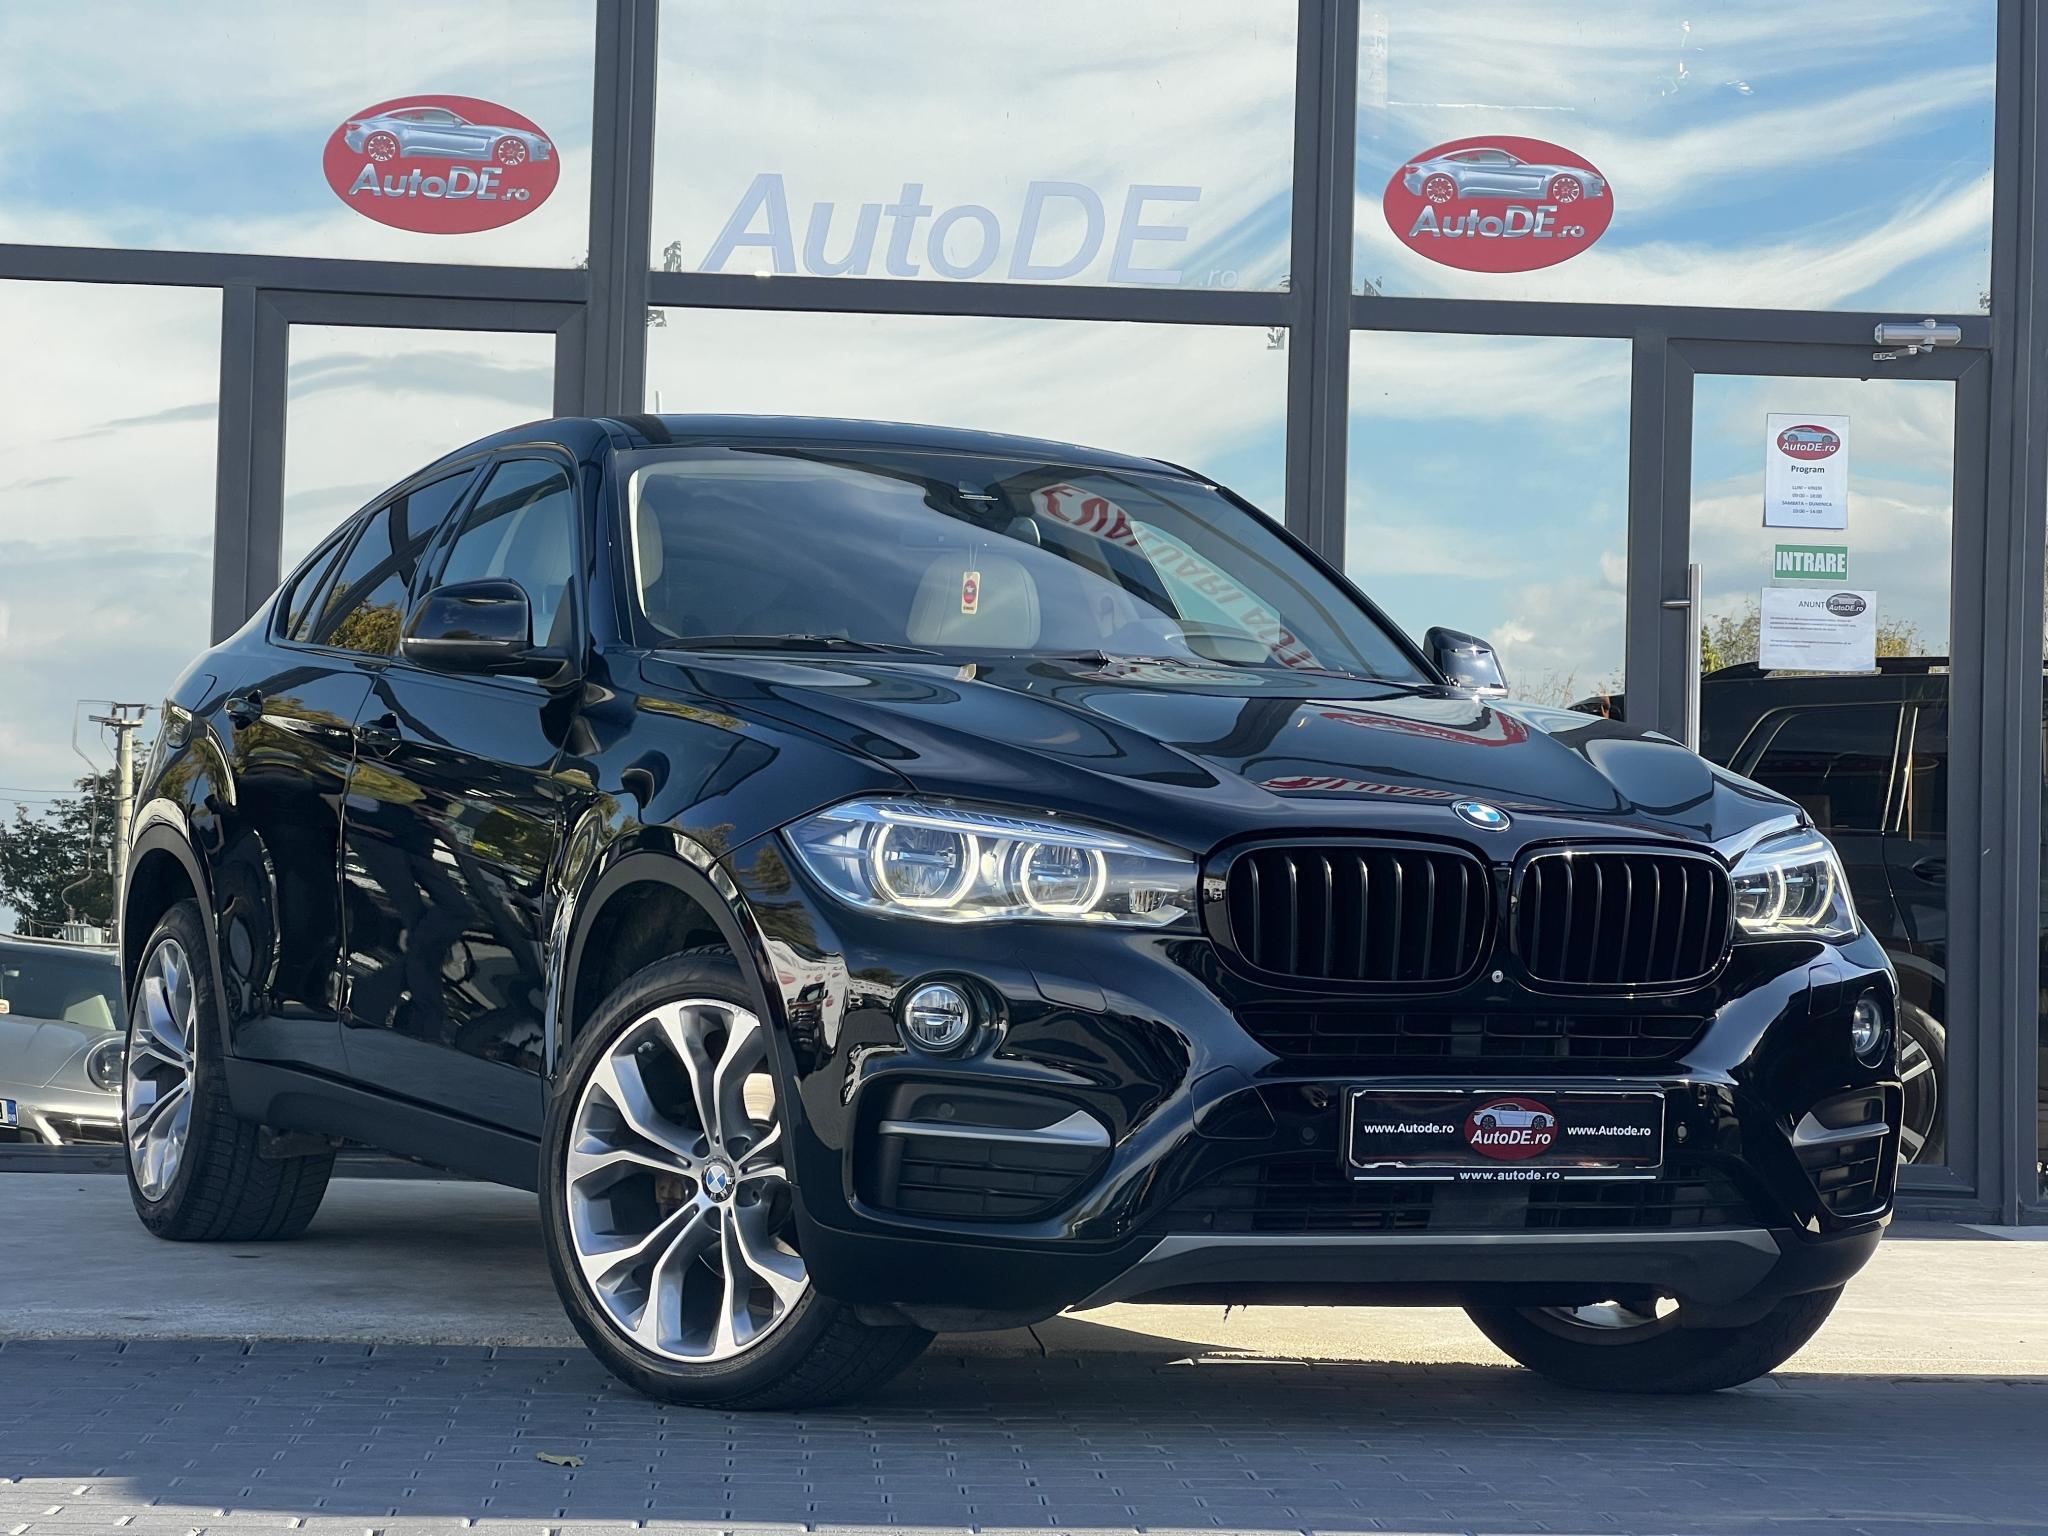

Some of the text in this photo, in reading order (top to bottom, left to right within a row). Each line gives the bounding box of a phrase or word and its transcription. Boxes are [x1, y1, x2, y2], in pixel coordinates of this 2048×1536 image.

[1781, 442, 1836, 452] AutoDE.ro
[1791, 465, 1825, 474] Program
[1776, 552, 1845, 573] INTRARE
[1798, 600, 1825, 609] ANUNT
[1364, 1122, 1454, 1135] www.Autode.ro
[1567, 1125, 1651, 1137] www.Autode.ro
[1470, 1129, 1551, 1146] AutoDE.ro
[1459, 1170, 1561, 1181] www.autode.ro
